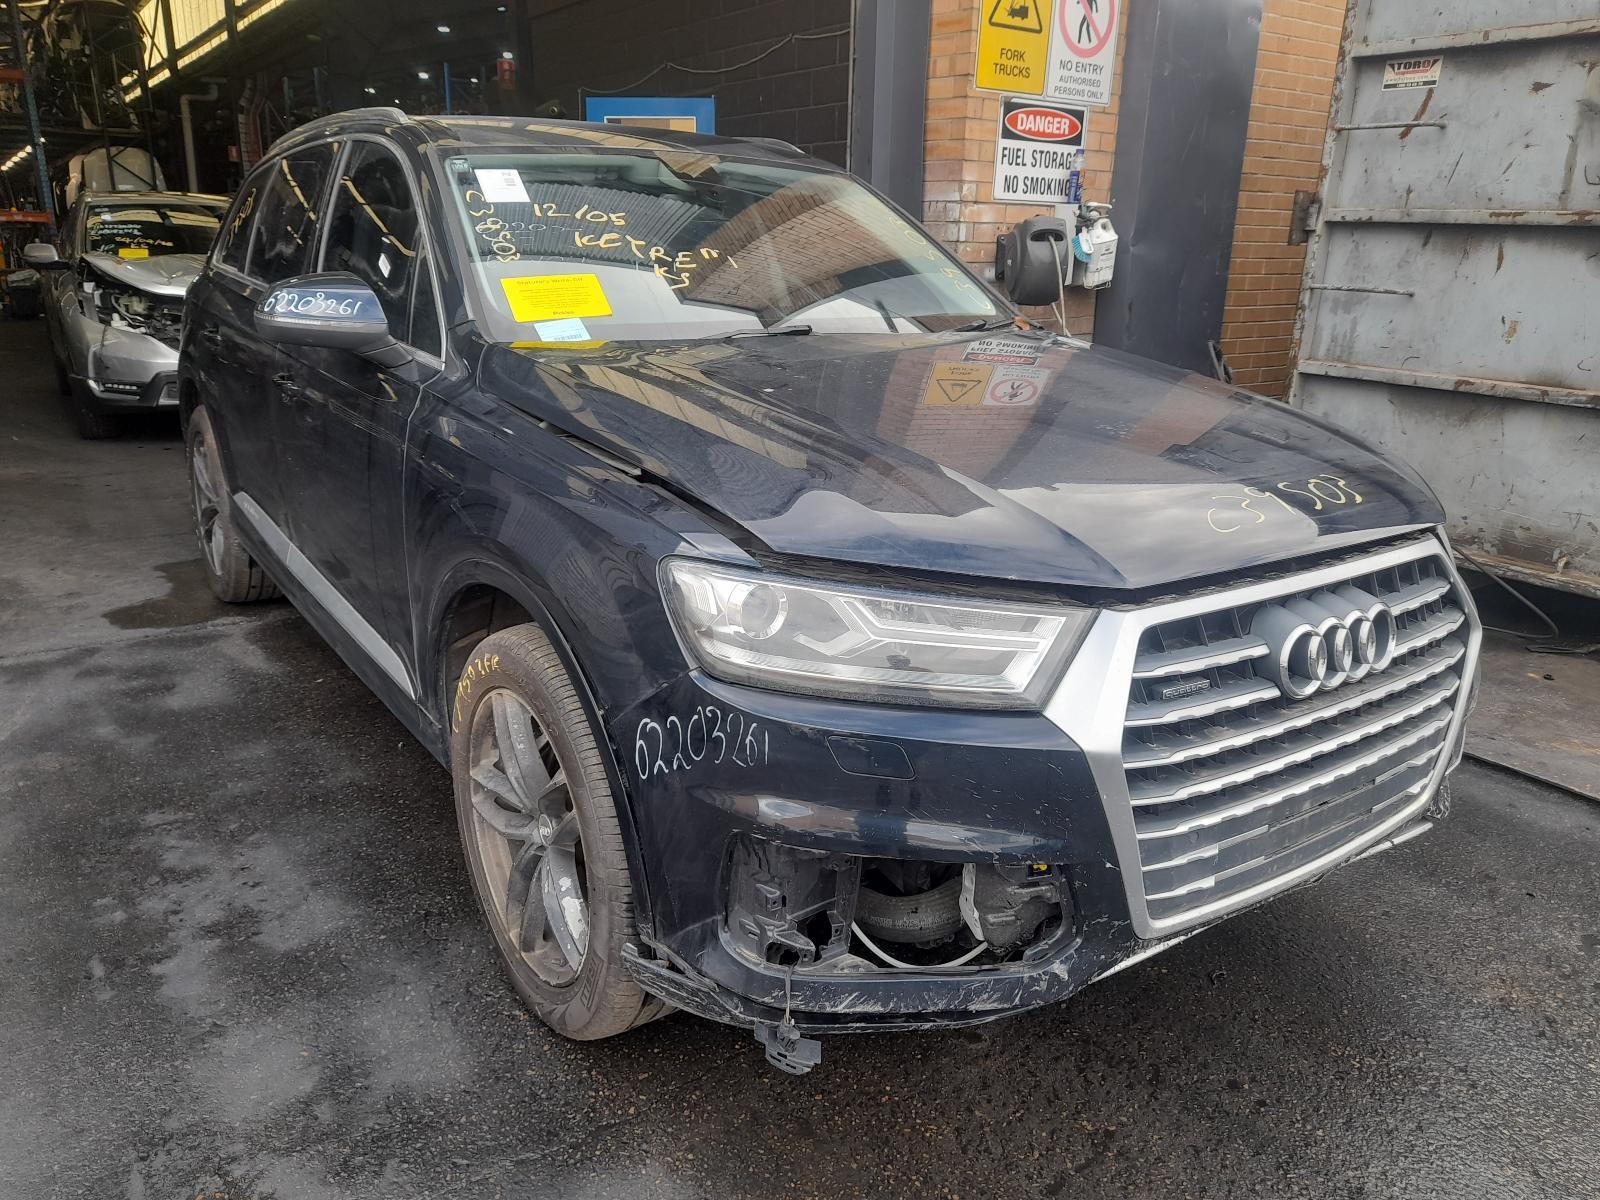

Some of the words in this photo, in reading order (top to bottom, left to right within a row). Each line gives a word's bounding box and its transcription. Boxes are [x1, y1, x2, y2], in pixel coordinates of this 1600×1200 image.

[1000, 48, 1026, 62] FORK
[993, 63, 1031, 78] TRUCKS
[1060, 60, 1072, 72] NO
[1075, 61, 1104, 75] ENTRY
[1059, 75, 1101, 88] AUTHORISED
[1054, 86, 1085, 97] PERSONS
[1087, 91, 1103, 100] ONLY
[1017, 113, 1070, 135] DANGER
[1001, 146, 1027, 166] FUEL
[1003, 174, 1018, 193] NO
[635, 705, 769, 780] 62203261
